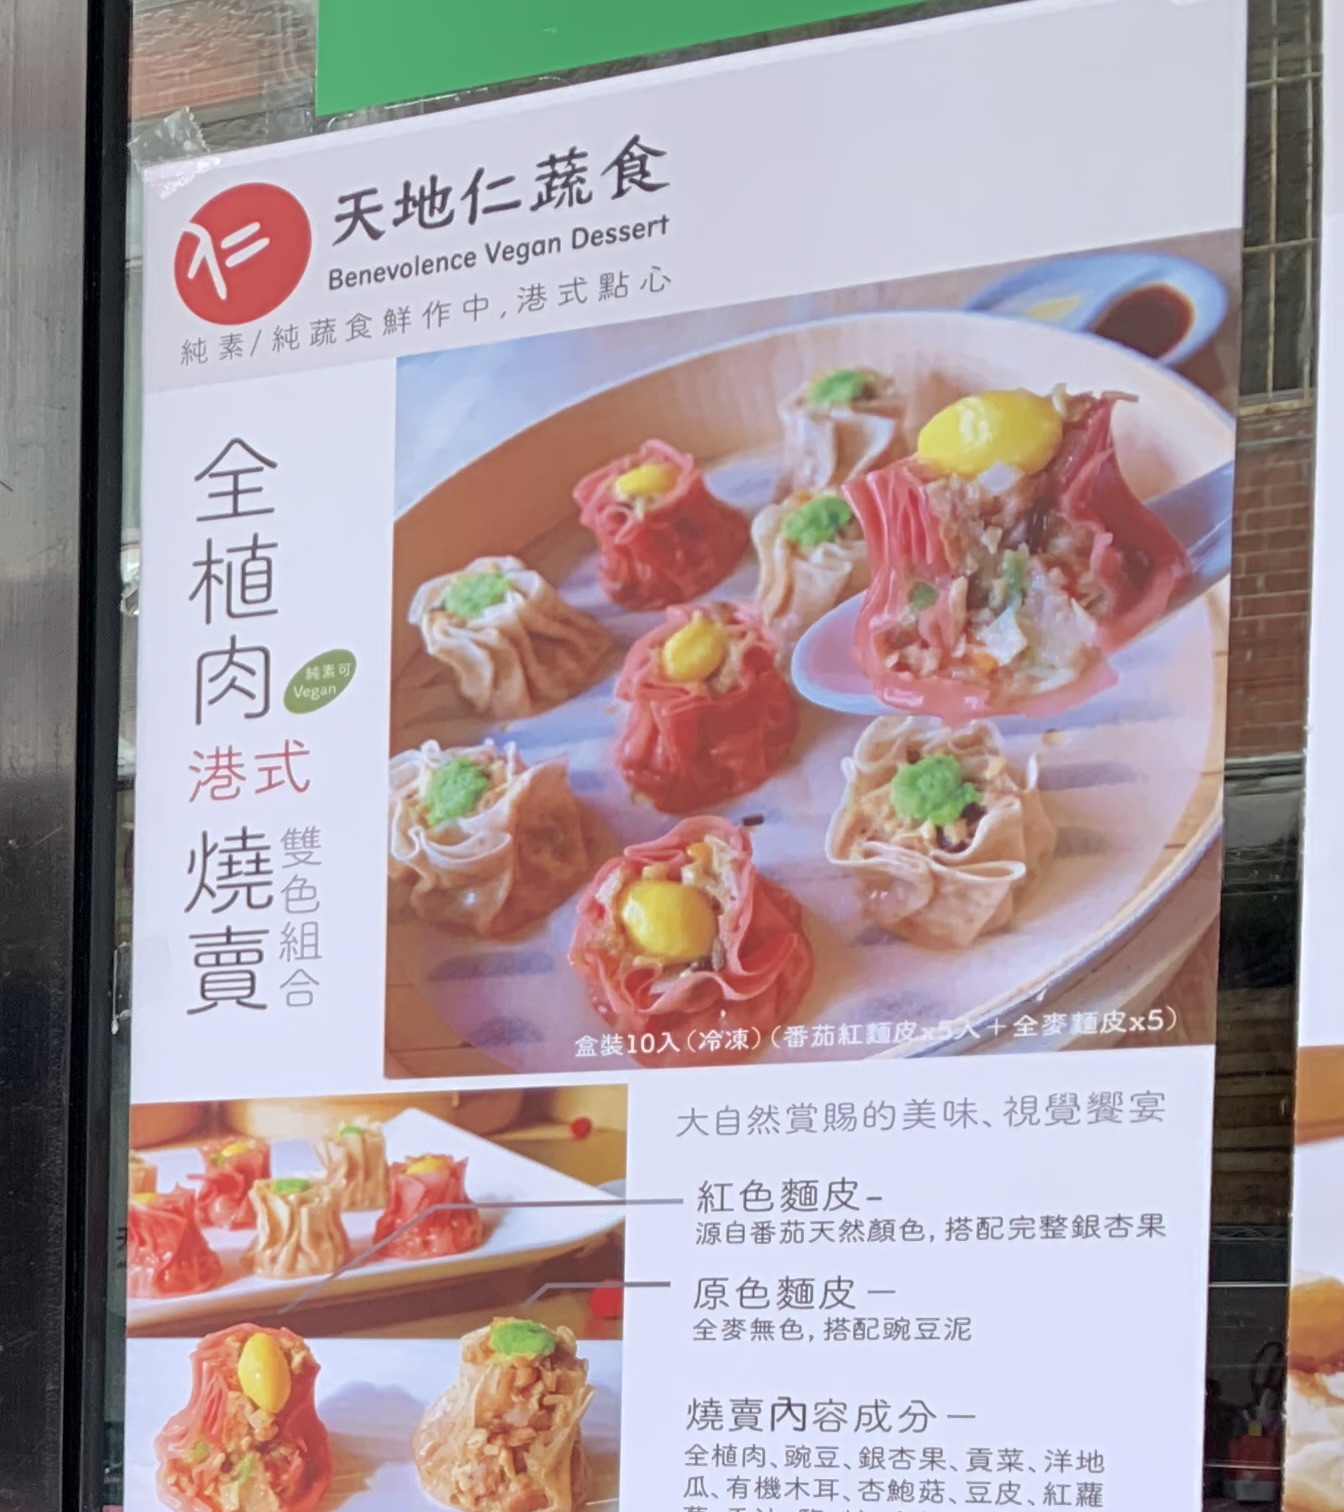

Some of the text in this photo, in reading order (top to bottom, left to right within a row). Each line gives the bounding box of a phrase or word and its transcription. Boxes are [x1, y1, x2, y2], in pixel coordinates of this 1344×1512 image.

[332, 134, 670, 247] 天地仁蔬食
[328, 214, 670, 290] Benevolence Vegan Dessert
[188, 437, 279, 726] 全植肉
[293, 684, 337, 701] Vegan
[188, 738, 311, 804] 港式
[184, 825, 274, 1016] 燒賣
[278, 824, 323, 1009] 雙色組合
[676, 1090, 1166, 1137] 大自然賞賜的美味、視覺饗宴
[693, 1316, 972, 1343] 全麥無色,搭配豌豆泥
[683, 1475, 1105, 1508] 瓜、有機木耳、杏鮑菇、豆皮、紅蘿
[684, 1443, 1106, 1475] 全植肉、豌豆、銀杏果、貢菜、洋地
